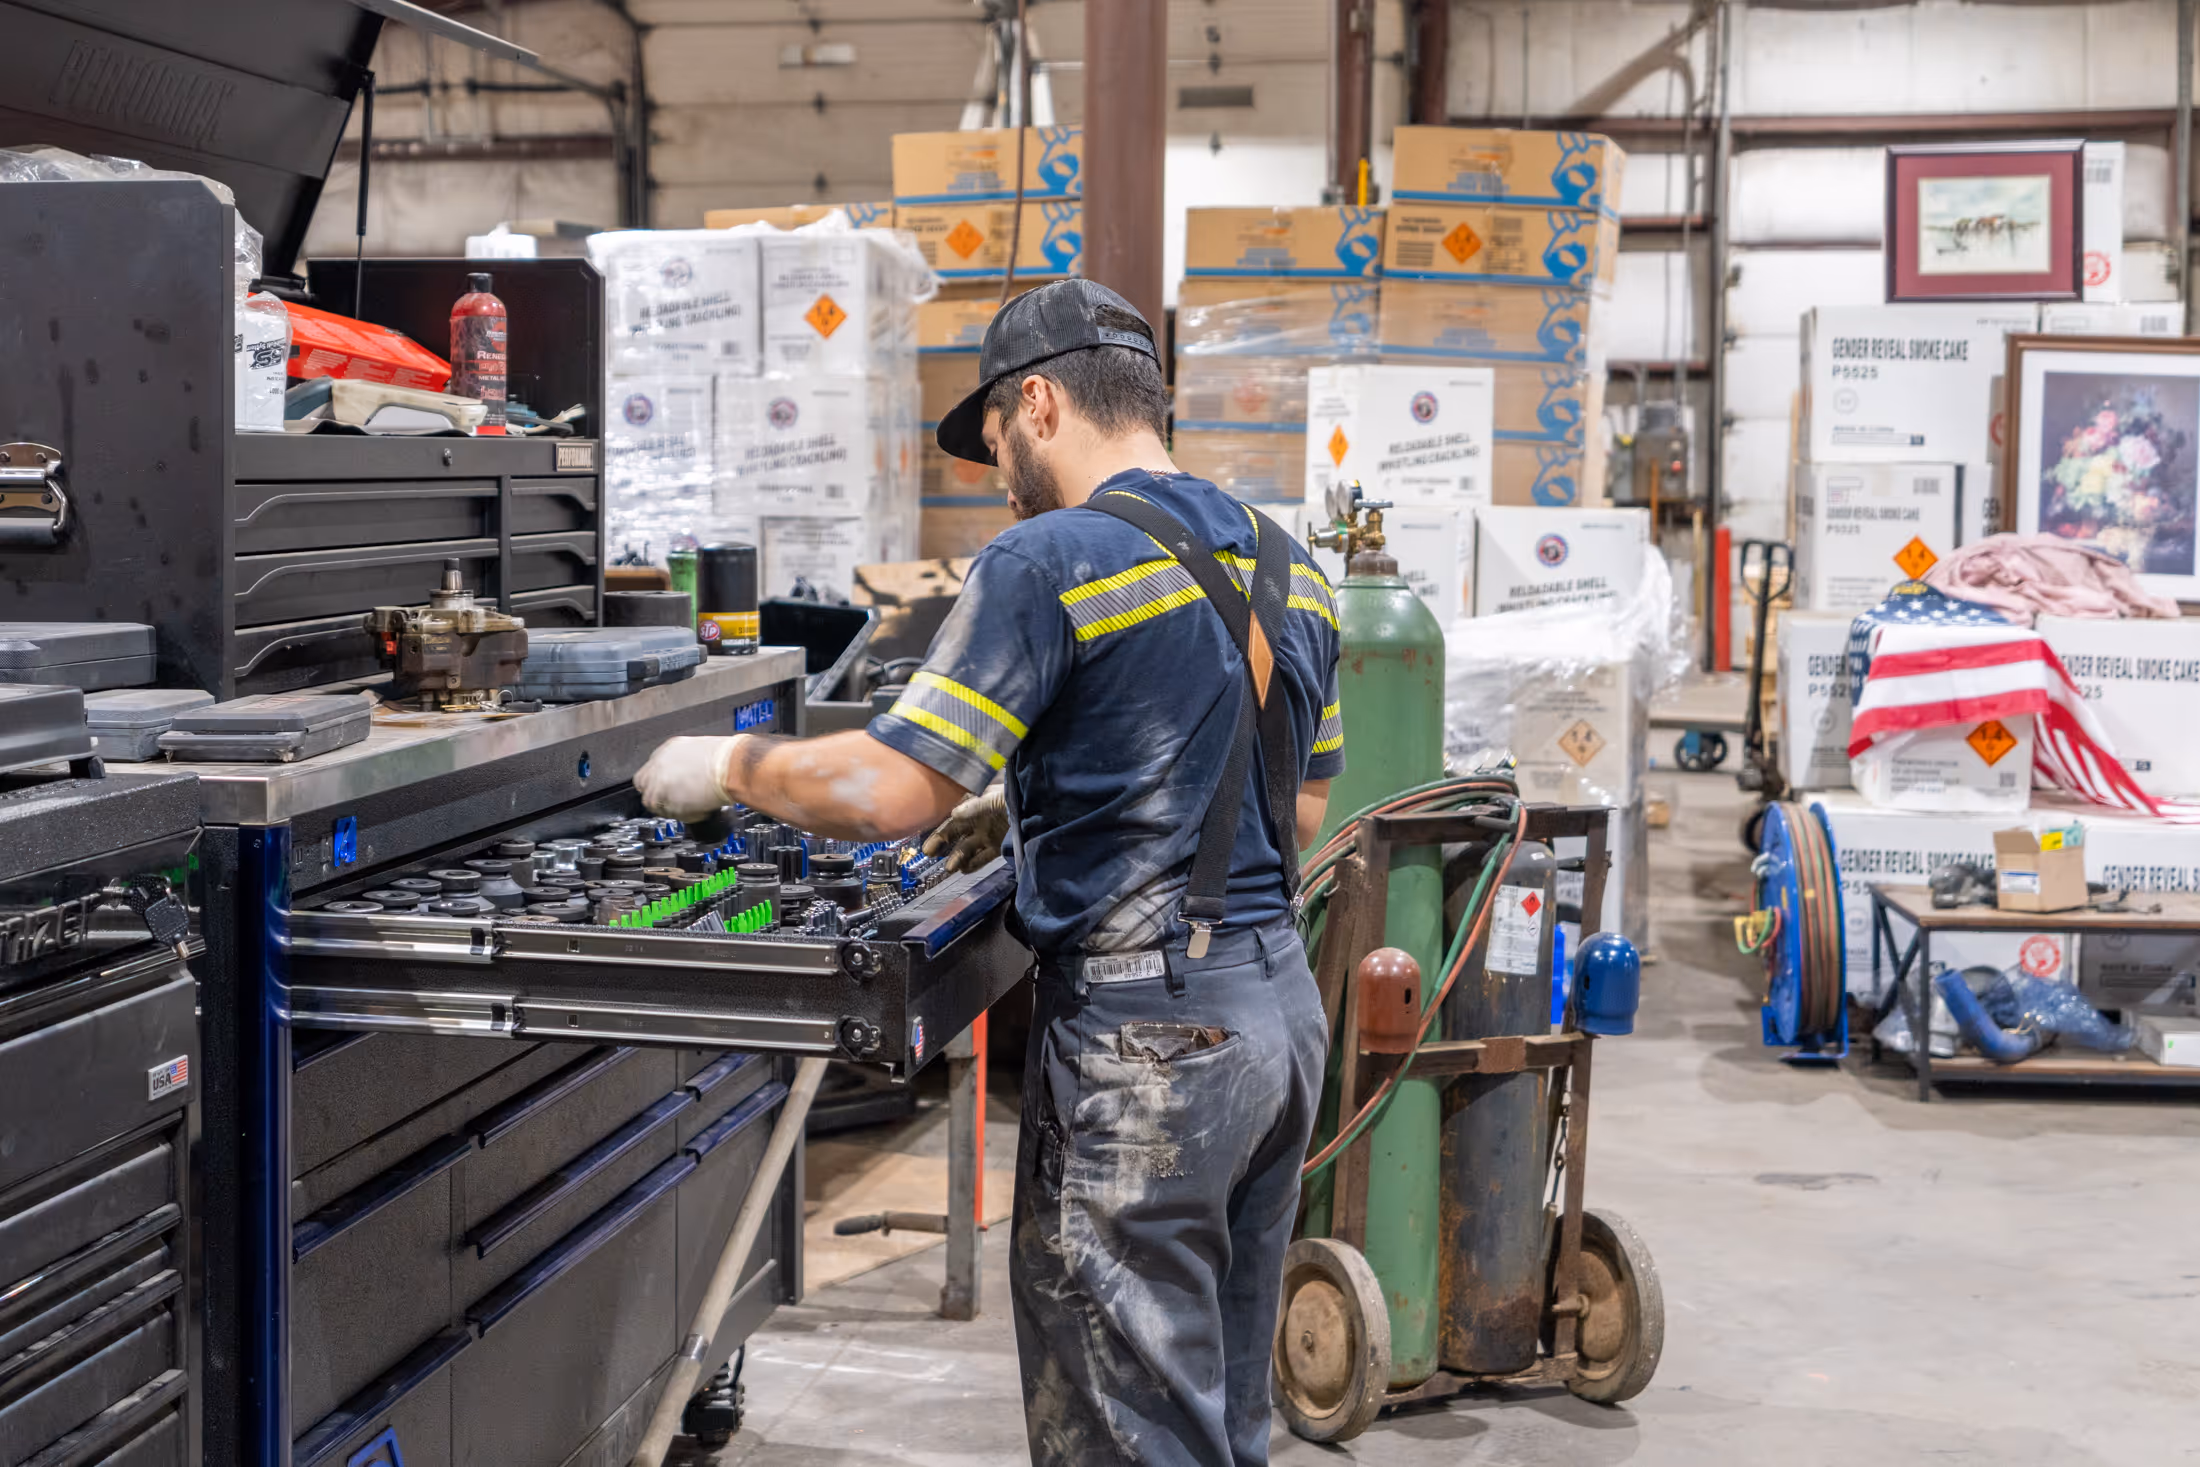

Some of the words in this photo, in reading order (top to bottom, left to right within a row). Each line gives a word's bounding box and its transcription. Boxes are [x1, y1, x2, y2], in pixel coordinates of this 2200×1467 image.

[1833, 337, 1869, 360] GENDER
[1872, 338, 1906, 360] REVEAL
[1909, 339, 1942, 361] SMOKE
[1944, 339, 1969, 361] CAKE
[701, 623, 717, 638] STP
[1808, 655, 1847, 676] GENDER
[2096, 656, 2134, 679] REVEAL
[2137, 658, 2171, 681] SMOKE
[2174, 660, 2200, 682] CAKE
[1841, 849, 1882, 873] GENDER
[1885, 850, 1924, 874] REVEAL
[2103, 865, 2146, 891] GENDER
[2150, 866, 2190, 892] REVEAL
[153, 1072, 172, 1092] USA
